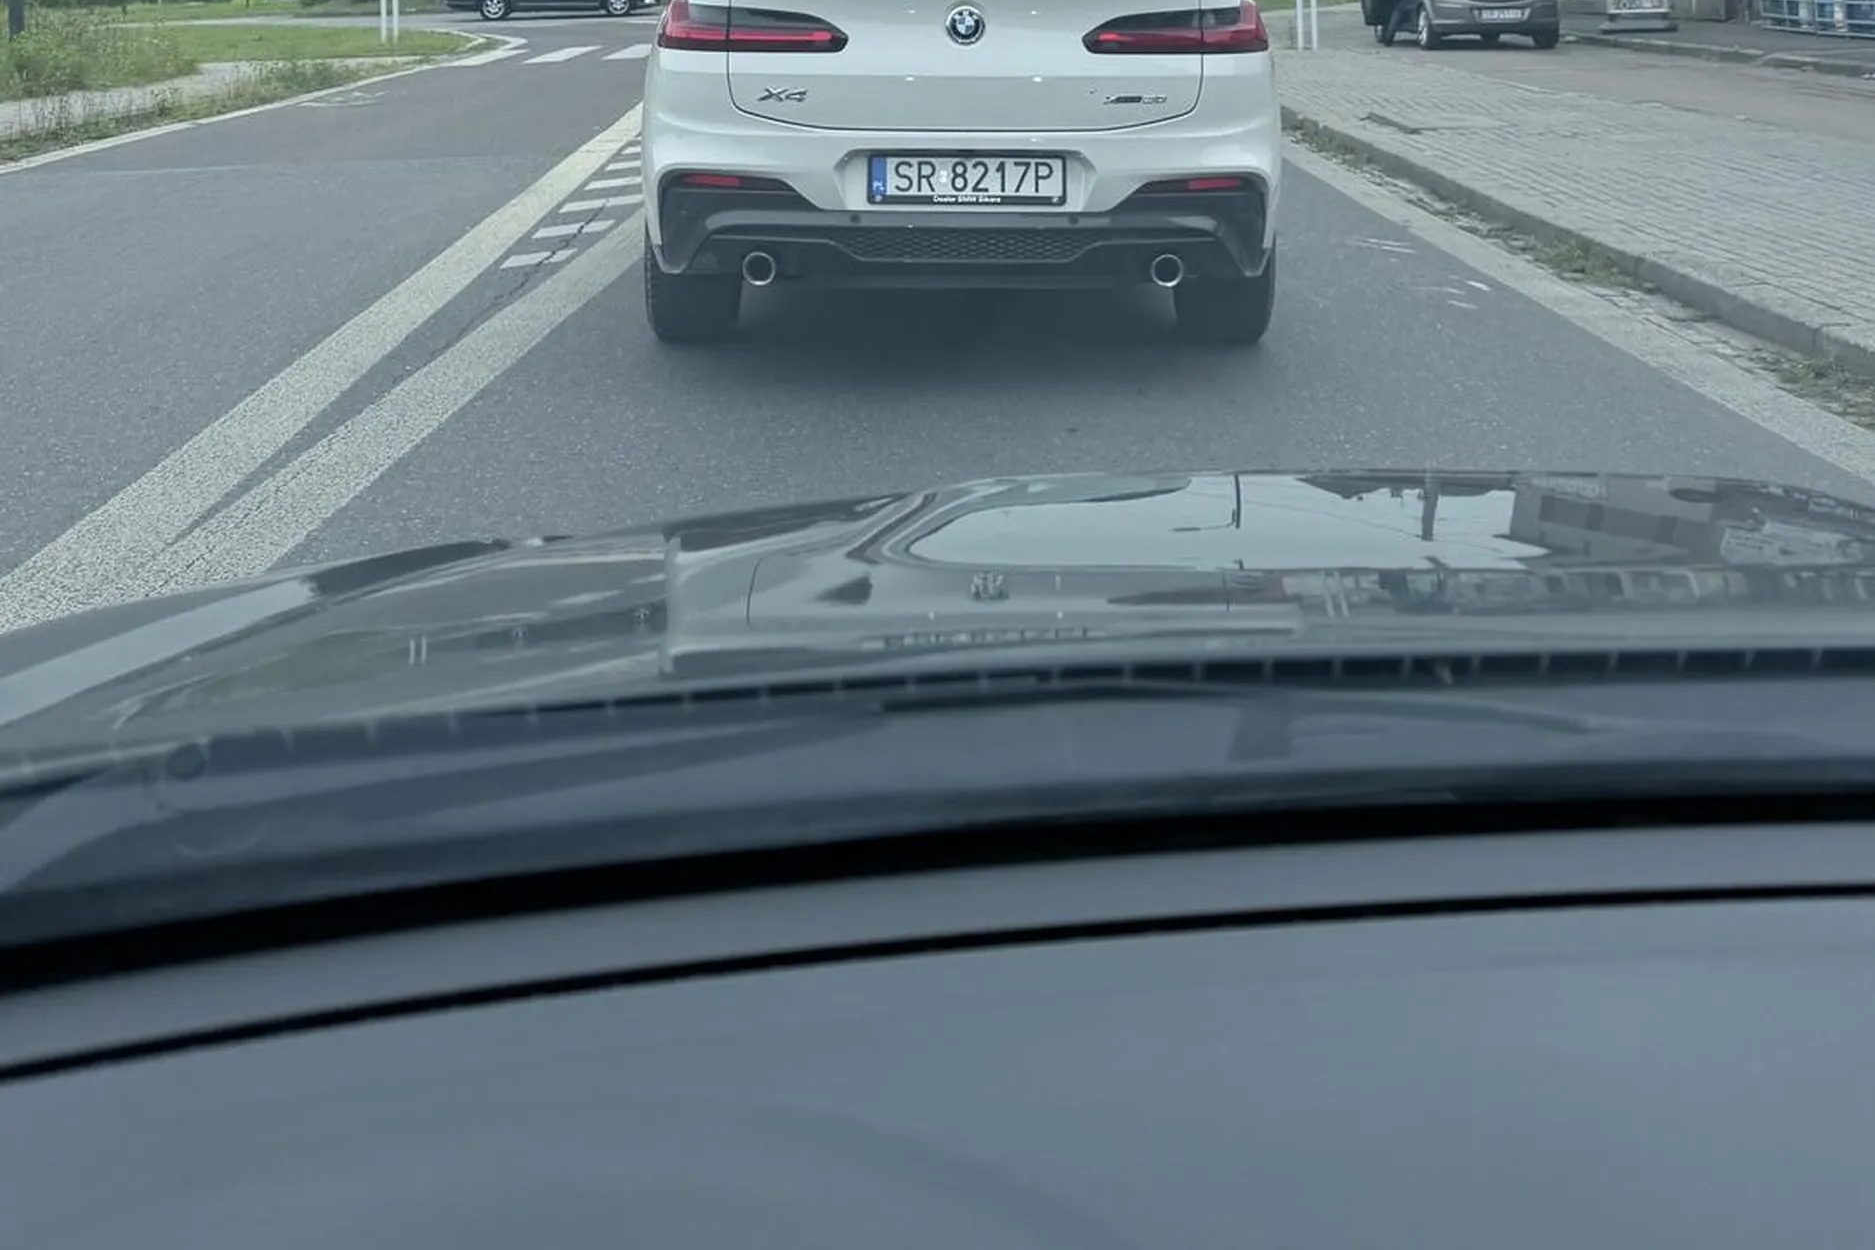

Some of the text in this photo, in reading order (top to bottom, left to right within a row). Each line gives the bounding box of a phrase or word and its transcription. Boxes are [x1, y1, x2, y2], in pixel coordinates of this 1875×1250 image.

[757, 88, 808, 103] X4
[894, 160, 1054, 193] SR 8217P
